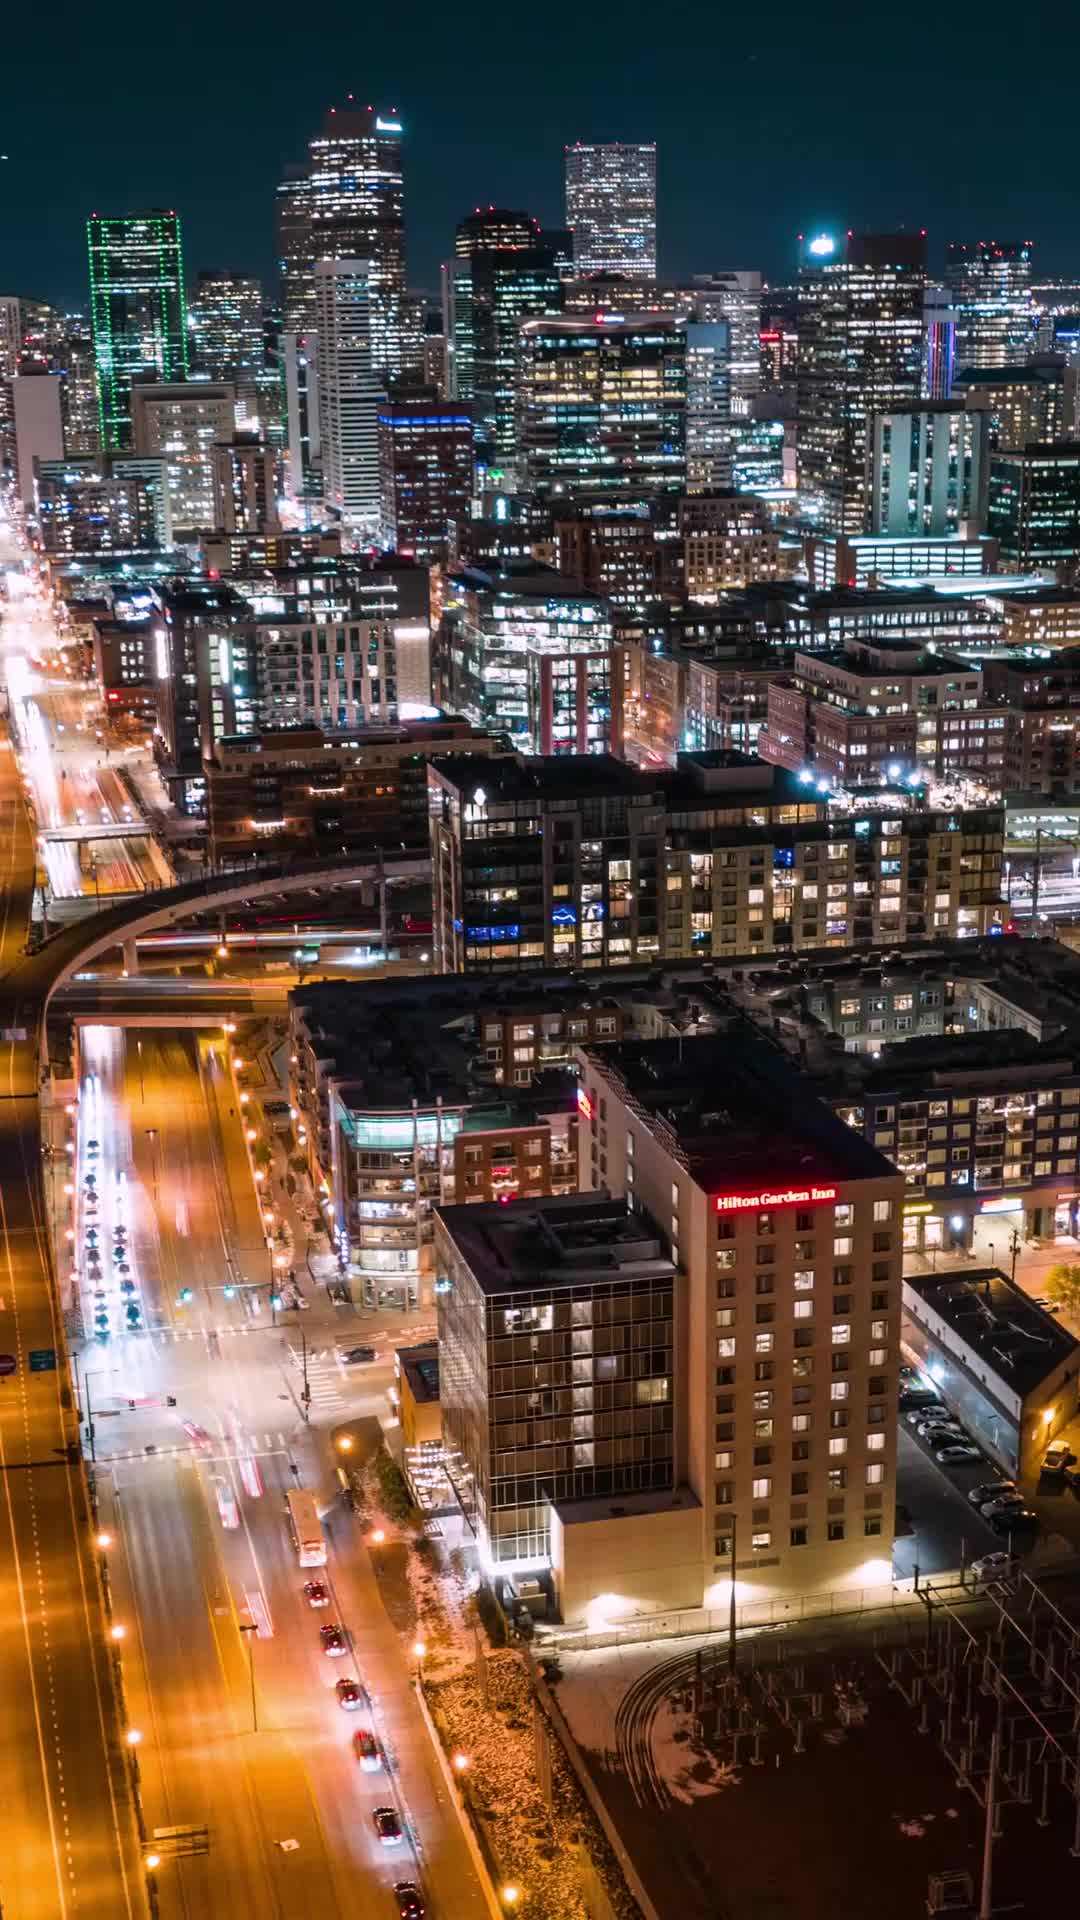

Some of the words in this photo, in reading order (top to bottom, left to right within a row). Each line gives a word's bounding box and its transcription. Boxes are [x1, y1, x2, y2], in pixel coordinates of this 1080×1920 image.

[717, 1195, 759, 1209] Hilton
[760, 1190, 809, 1205] Garden
[811, 1188, 835, 1200] Inn
